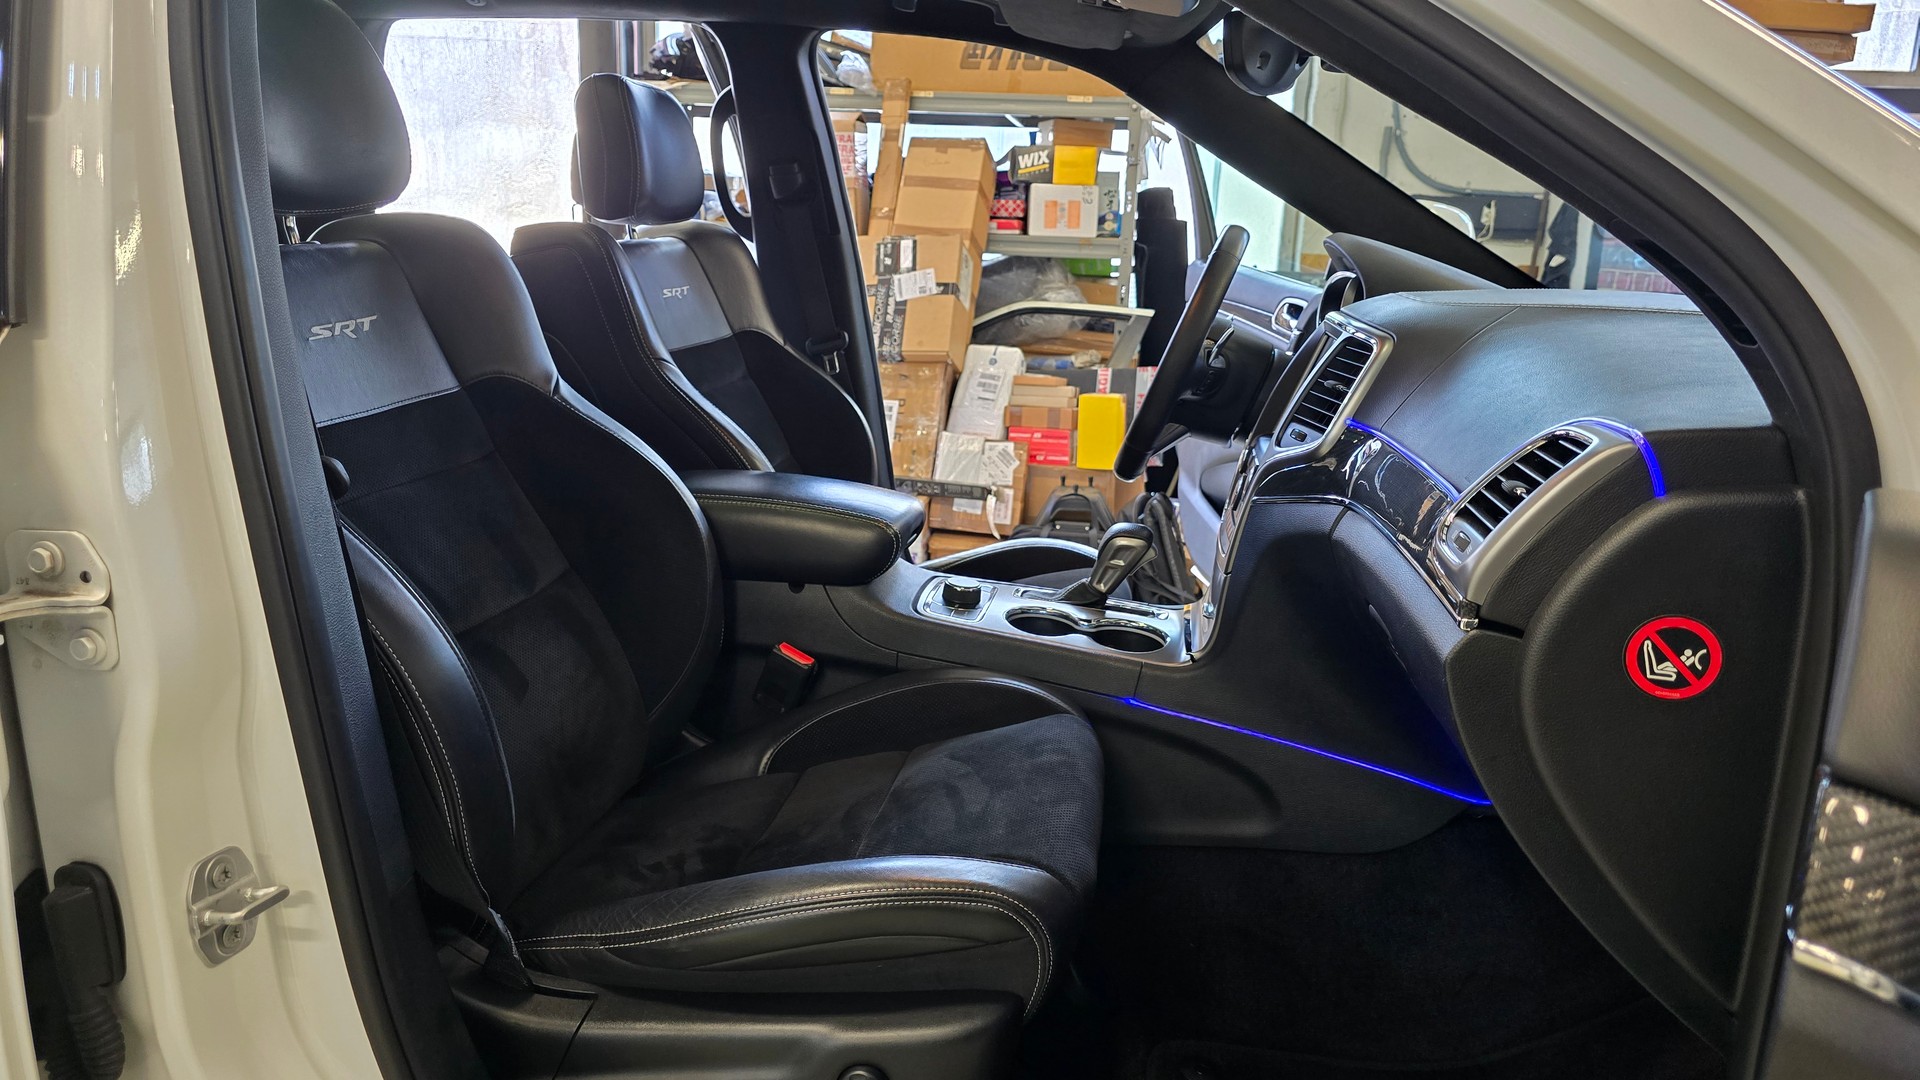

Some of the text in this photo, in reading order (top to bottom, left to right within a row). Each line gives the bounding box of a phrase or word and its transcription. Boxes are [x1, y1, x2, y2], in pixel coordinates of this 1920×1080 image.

[1018, 149, 1050, 169] WIX
[662, 285, 690, 299] SRT
[308, 314, 378, 341] SRT
